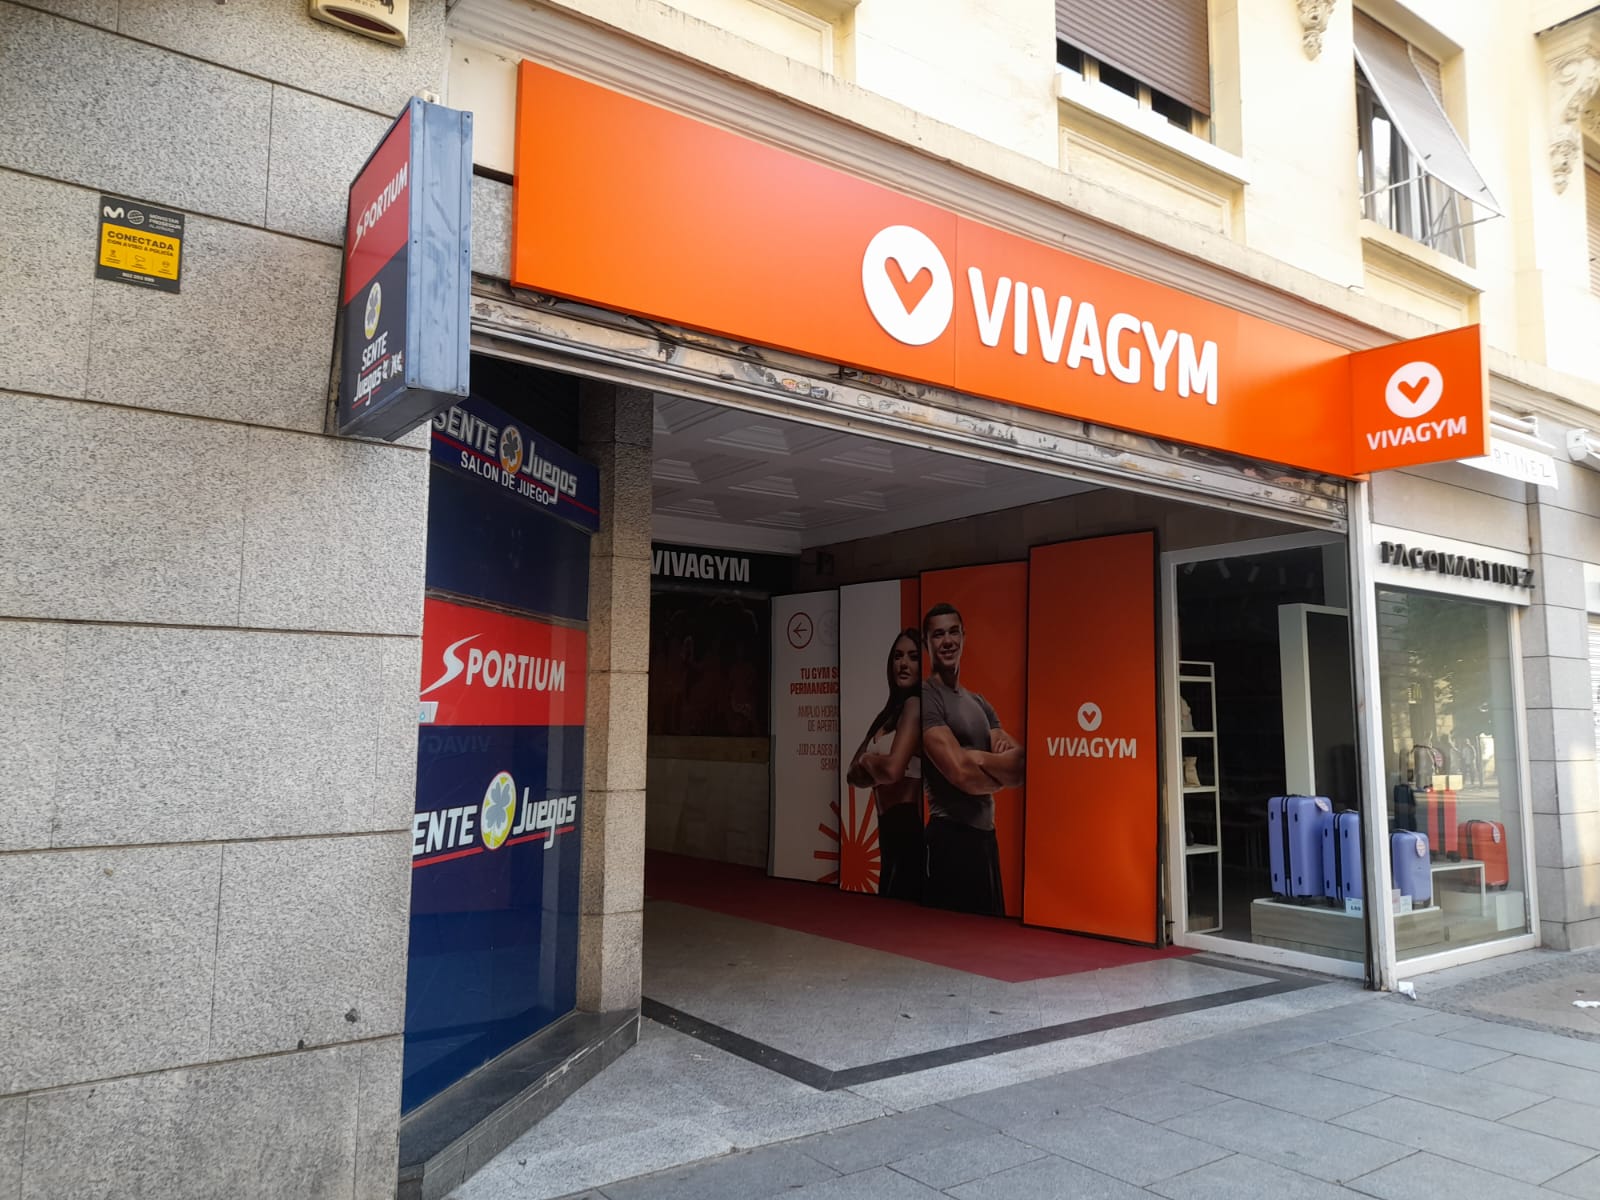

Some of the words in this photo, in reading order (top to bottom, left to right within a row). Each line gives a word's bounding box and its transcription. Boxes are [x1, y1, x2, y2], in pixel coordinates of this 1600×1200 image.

[351, 162, 408, 256] SPORTIUM
[107, 231, 174, 251] CONECTADA
[107, 238, 122, 247] CON
[123, 241, 143, 251] AVISO
[361, 331, 388, 371] SENTE
[968, 266, 1218, 406] VIVAGYM
[1366, 415, 1468, 451] VIVAGYM
[460, 450, 500, 483] SALON
[501, 471, 516, 491] DE
[517, 479, 549, 505] JUEGO
[522, 441, 577, 505] Juegos
[651, 550, 750, 582] VIVAGYM
[1380, 540, 1535, 589] PACOMARTINEZ
[420, 633, 566, 697] SPORTIUM
[800, 667, 811, 680] TU
[812, 667, 830, 679] GYM
[807, 719, 816, 732] DE
[810, 744, 833, 756] CLASES
[1047, 736, 1137, 759] VIVAGYM
[513, 787, 577, 850] Juegos
